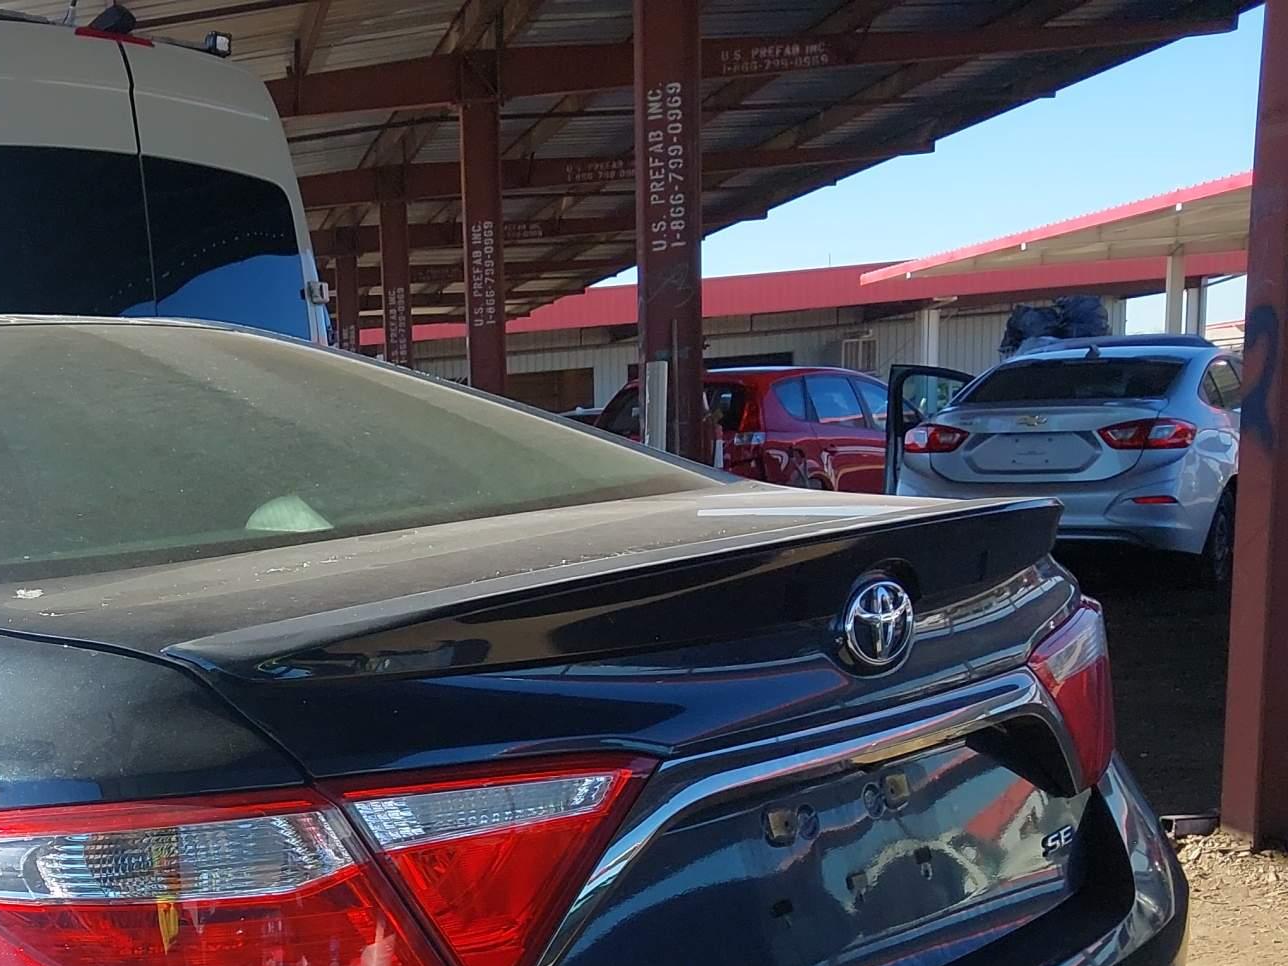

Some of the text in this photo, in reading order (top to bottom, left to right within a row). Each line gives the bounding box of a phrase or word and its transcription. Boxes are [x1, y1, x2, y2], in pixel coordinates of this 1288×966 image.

[751, 43, 800, 59] PREFAB
[647, 82, 668, 252] U.S. PREFAB INC.
[666, 82, 686, 247] 1-866-799-0969
[472, 251, 484, 297] PREFAB
[484, 221, 496, 325] 1-866-799-0969
[1046, 824, 1073, 854] SE
